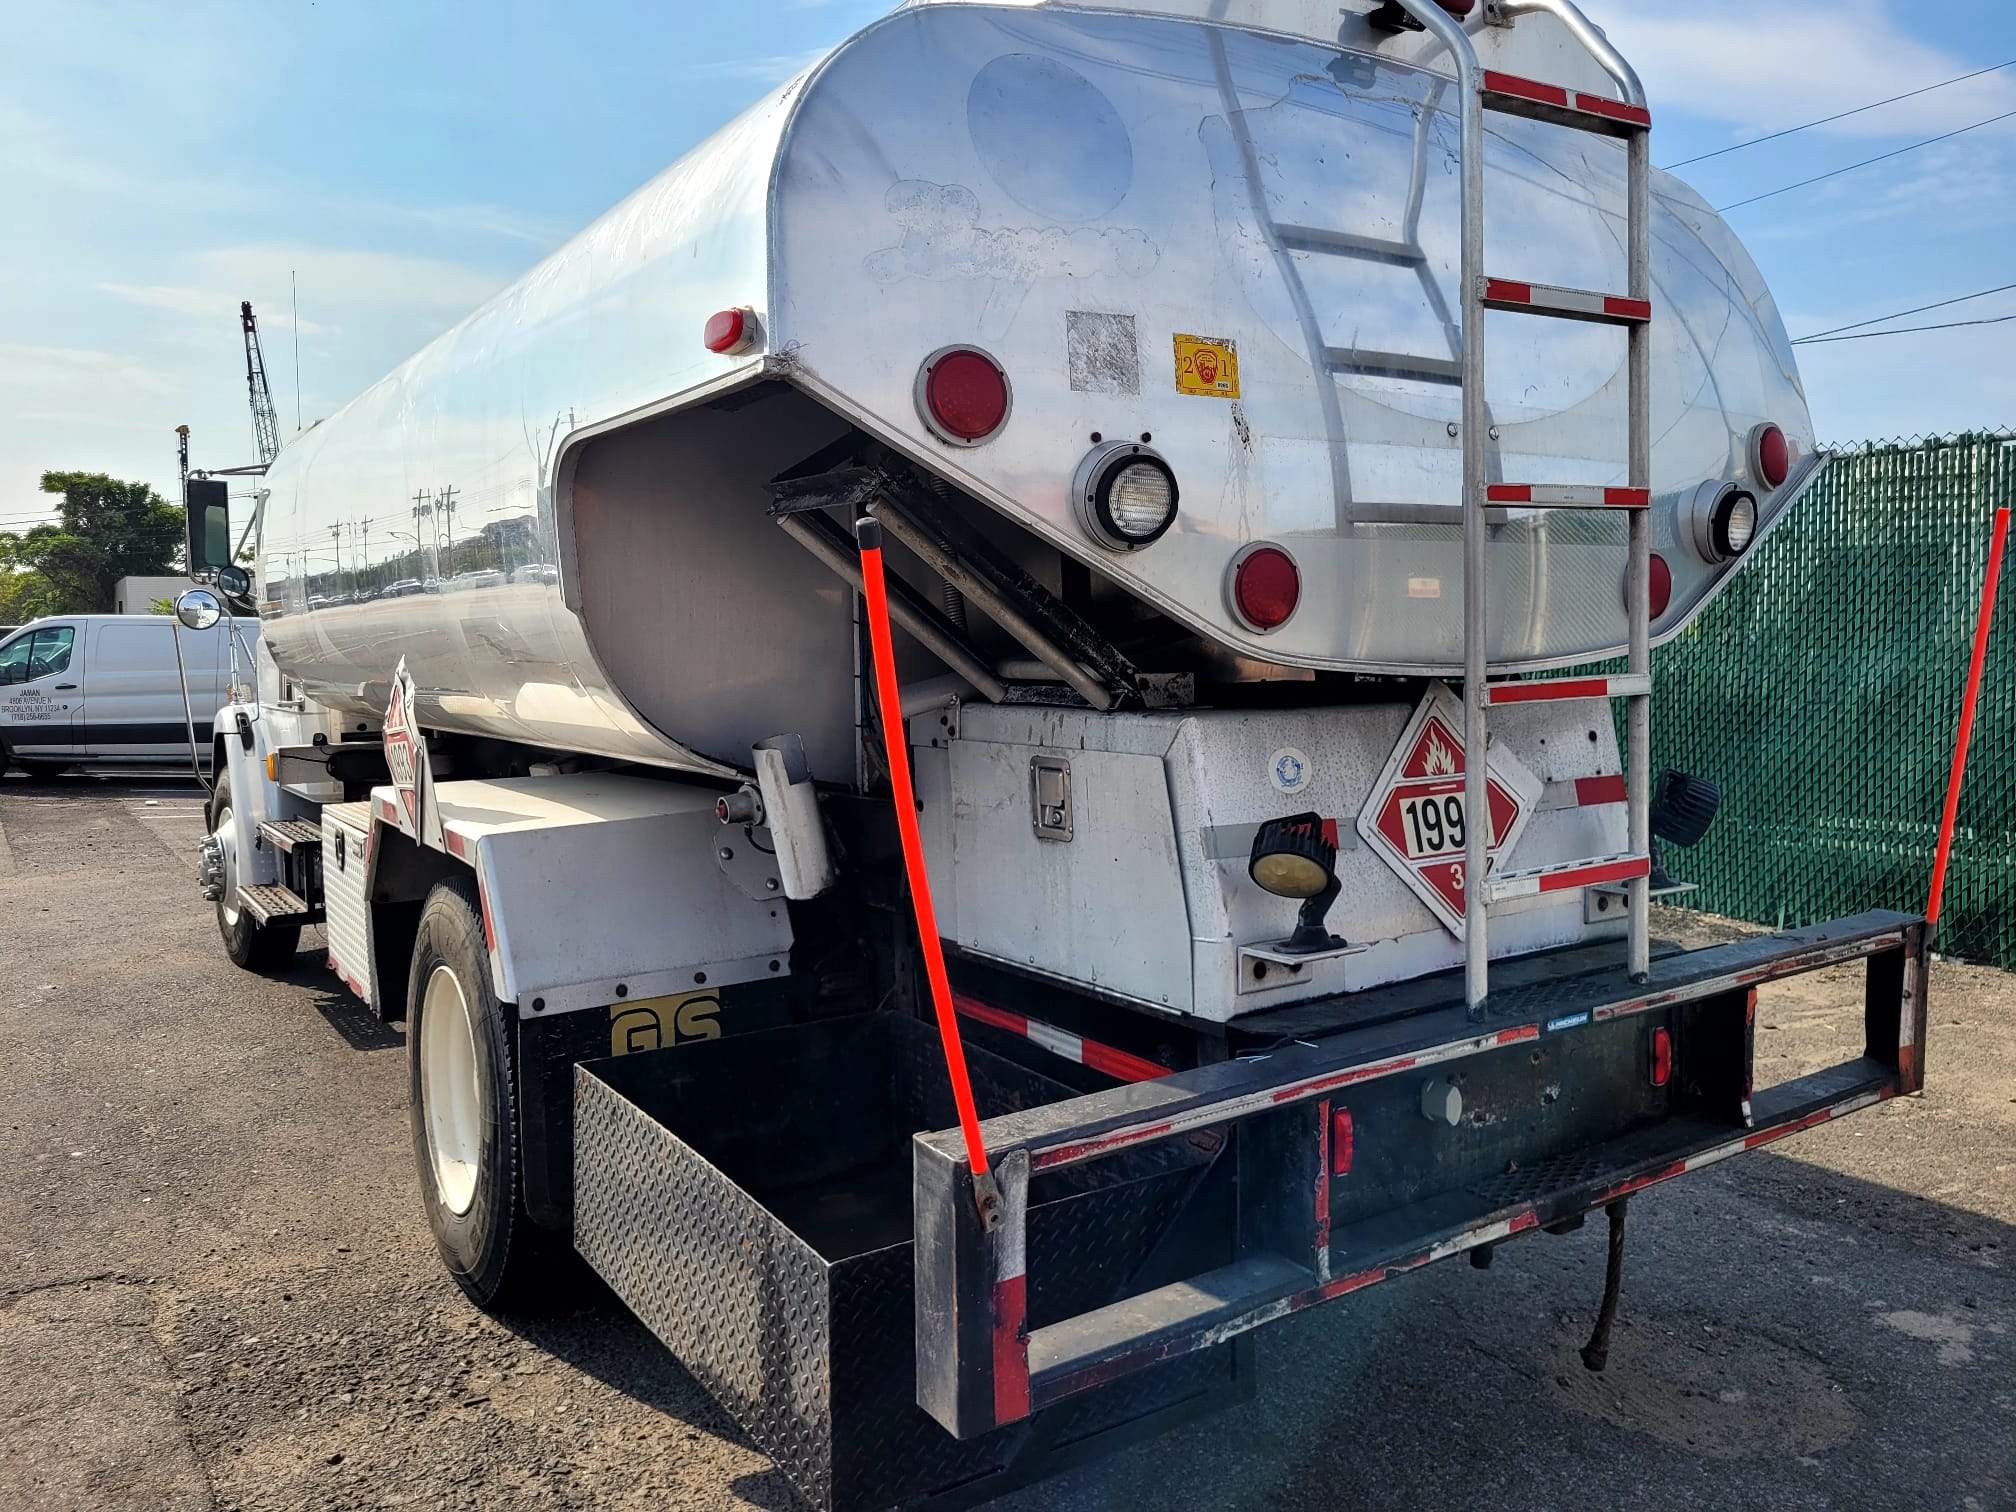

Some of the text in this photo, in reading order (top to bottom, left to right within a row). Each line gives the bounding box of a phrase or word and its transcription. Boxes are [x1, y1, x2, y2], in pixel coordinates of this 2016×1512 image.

[1183, 356, 1193, 374] 2
[23, 697, 47, 705] AVENUE
[1406, 795, 1488, 854] 199
[1449, 863, 1466, 890] 3
